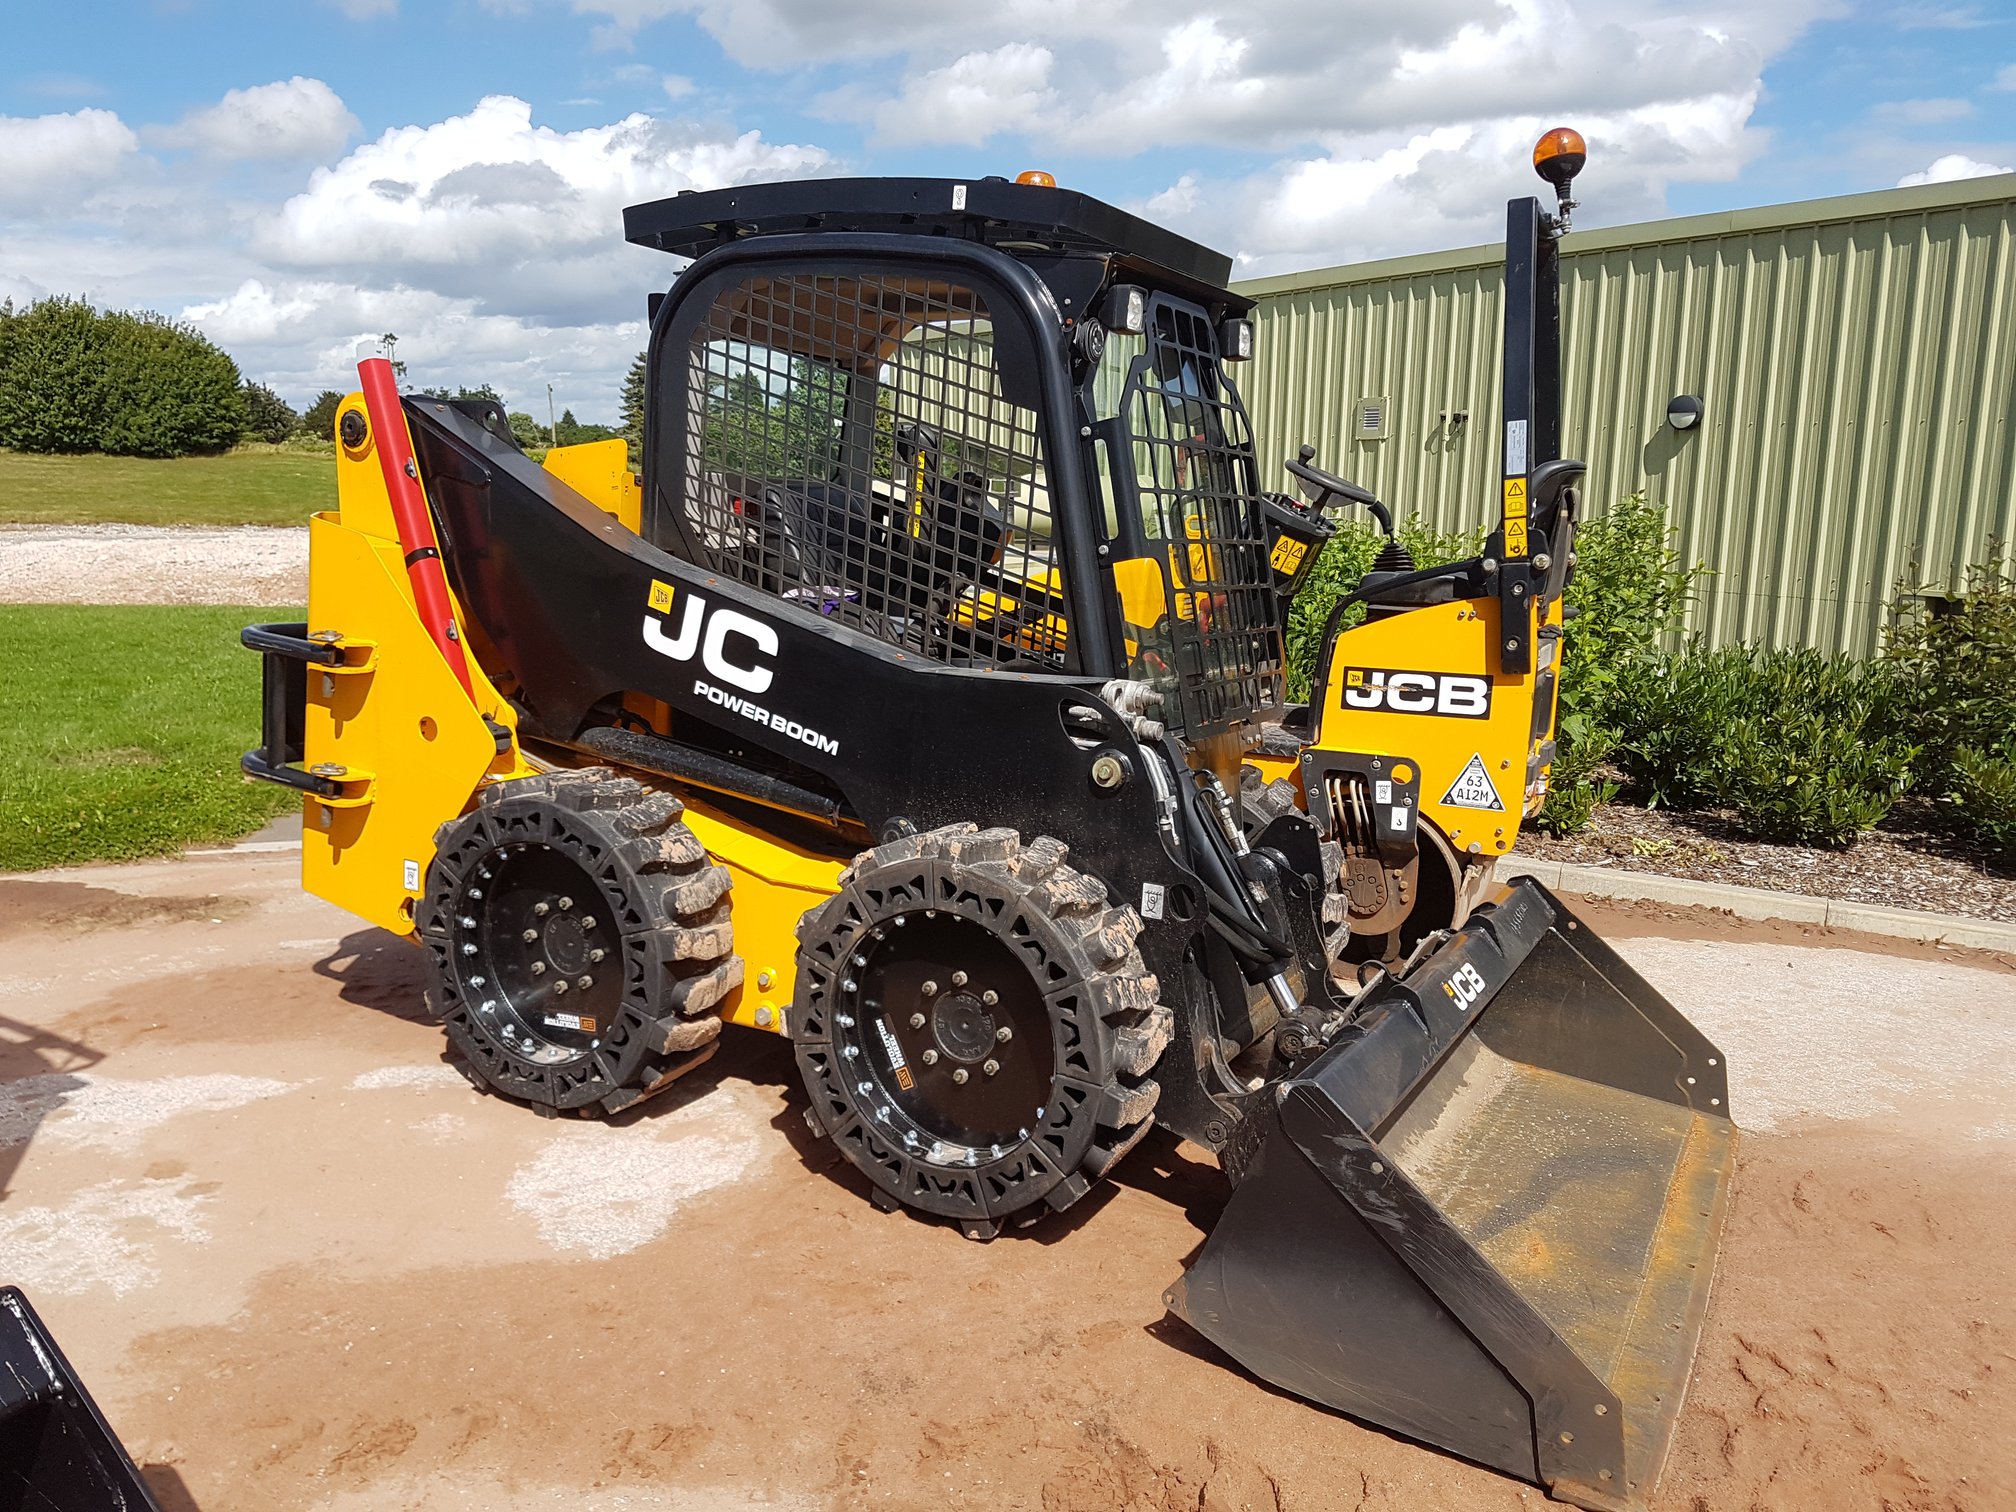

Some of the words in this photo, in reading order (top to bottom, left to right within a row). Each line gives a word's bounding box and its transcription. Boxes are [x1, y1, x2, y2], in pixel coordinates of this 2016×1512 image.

[655, 588, 668, 603] JCB
[643, 594, 779, 694] JC
[1345, 671, 1488, 716] JCB
[693, 680, 770, 726] POWER
[770, 714, 840, 756] BOOM
[1466, 775, 1483, 788] 63
[1447, 962, 1486, 1011] JCB
[875, 1018, 900, 1070] EVOLUTION
[888, 1034, 905, 1067] WHEEL
